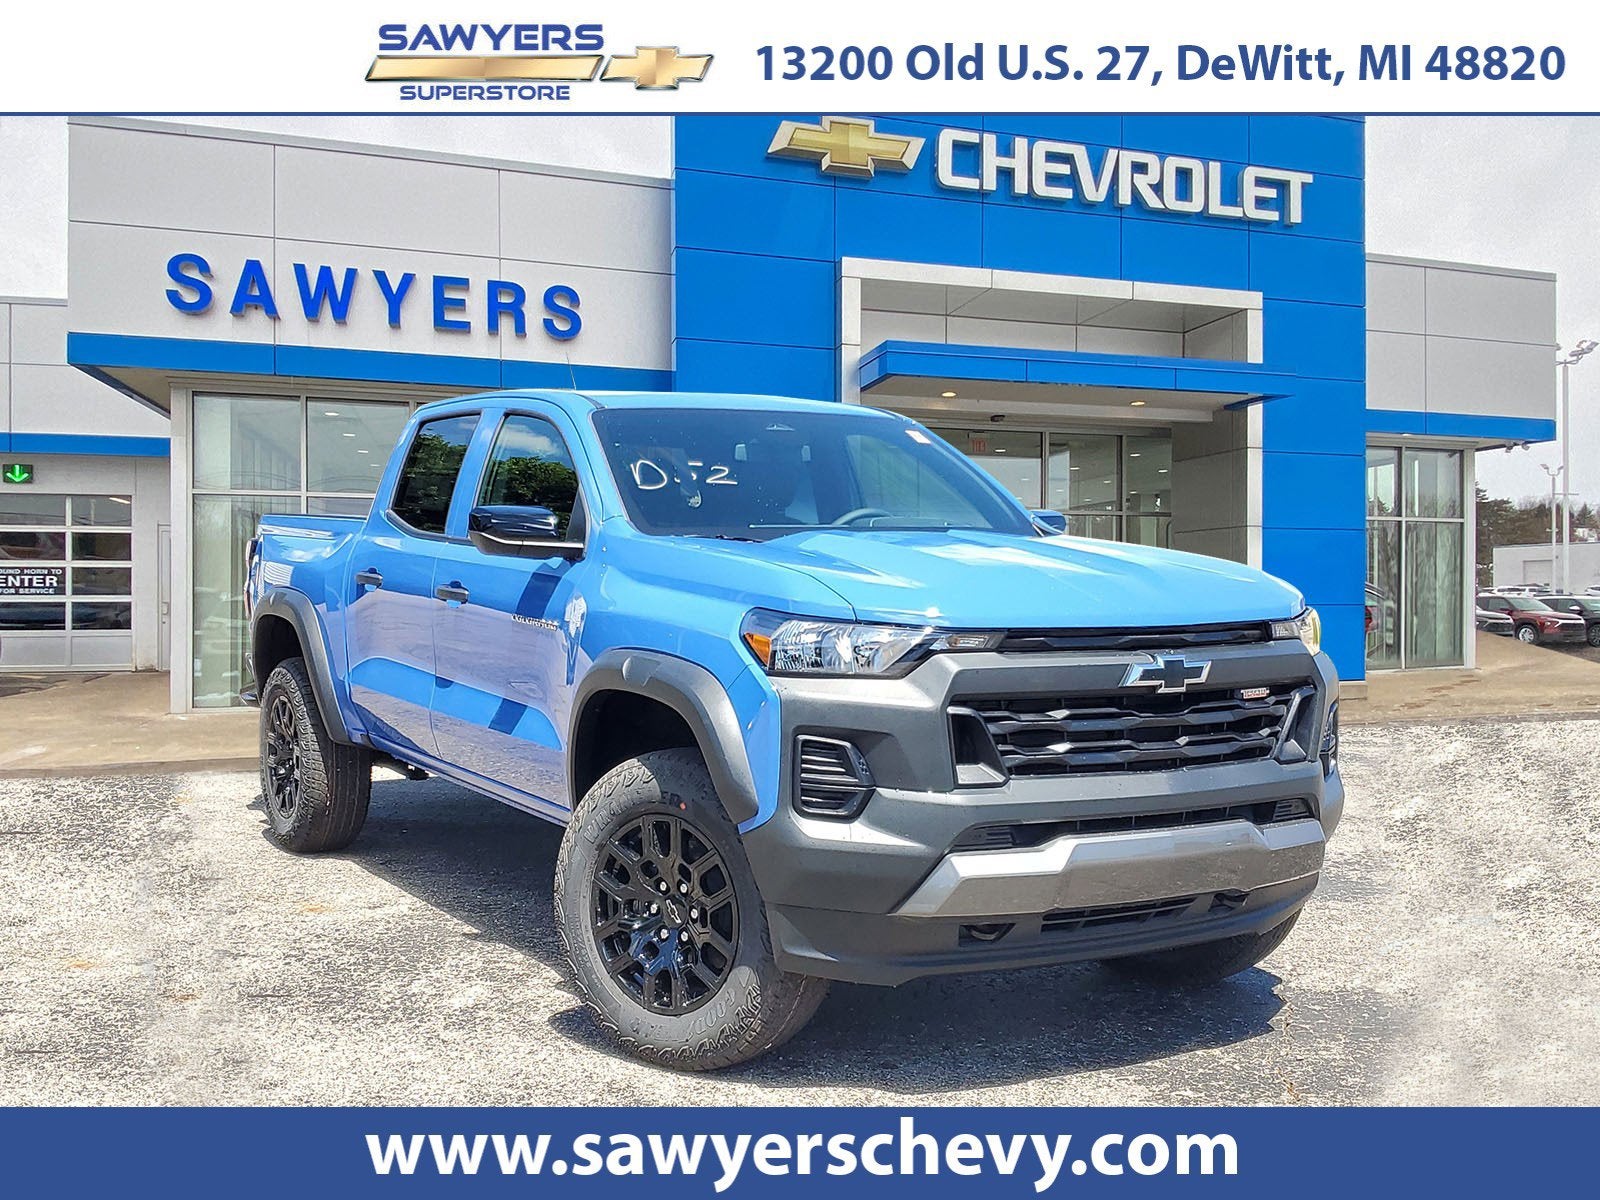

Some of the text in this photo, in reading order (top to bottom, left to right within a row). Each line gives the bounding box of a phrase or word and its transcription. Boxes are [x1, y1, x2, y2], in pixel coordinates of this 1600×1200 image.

[936, 126, 1313, 225] CHEVROLET
[165, 252, 583, 341] SAWYERS
[0, 575, 58, 587] ENTER
